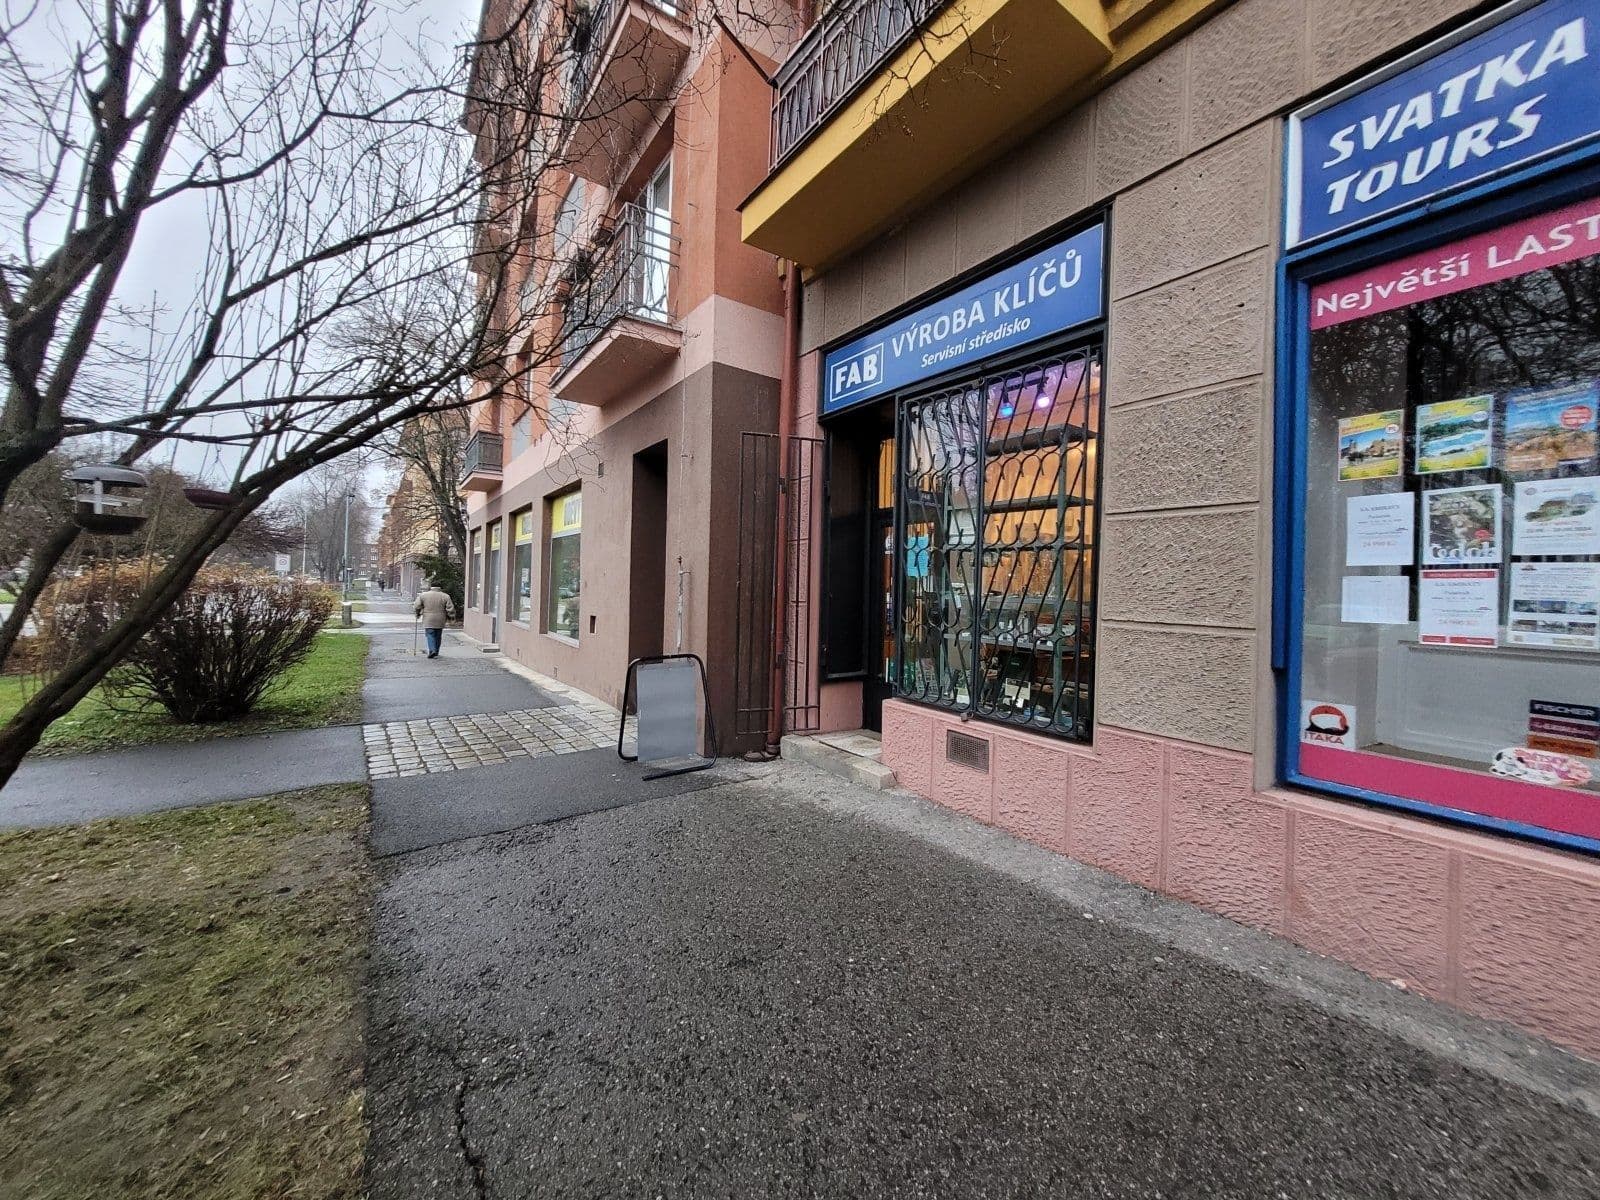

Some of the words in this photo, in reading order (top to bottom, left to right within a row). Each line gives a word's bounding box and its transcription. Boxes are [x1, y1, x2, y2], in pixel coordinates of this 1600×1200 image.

[1323, 17, 1588, 169] SVATKA
[1326, 93, 1547, 215] TOURS
[892, 300, 985, 358] VÝROBA
[994, 249, 1082, 317] KLÍČŮ
[1316, 252, 1470, 317] Největší
[1487, 214, 1600, 269] LAST
[835, 351, 878, 394] FAB
[920, 338, 967, 368] Servisní
[968, 317, 1031, 352] středisko
[1304, 732, 1344, 745] ITAKA
[1534, 703, 1595, 717] FISCHER
